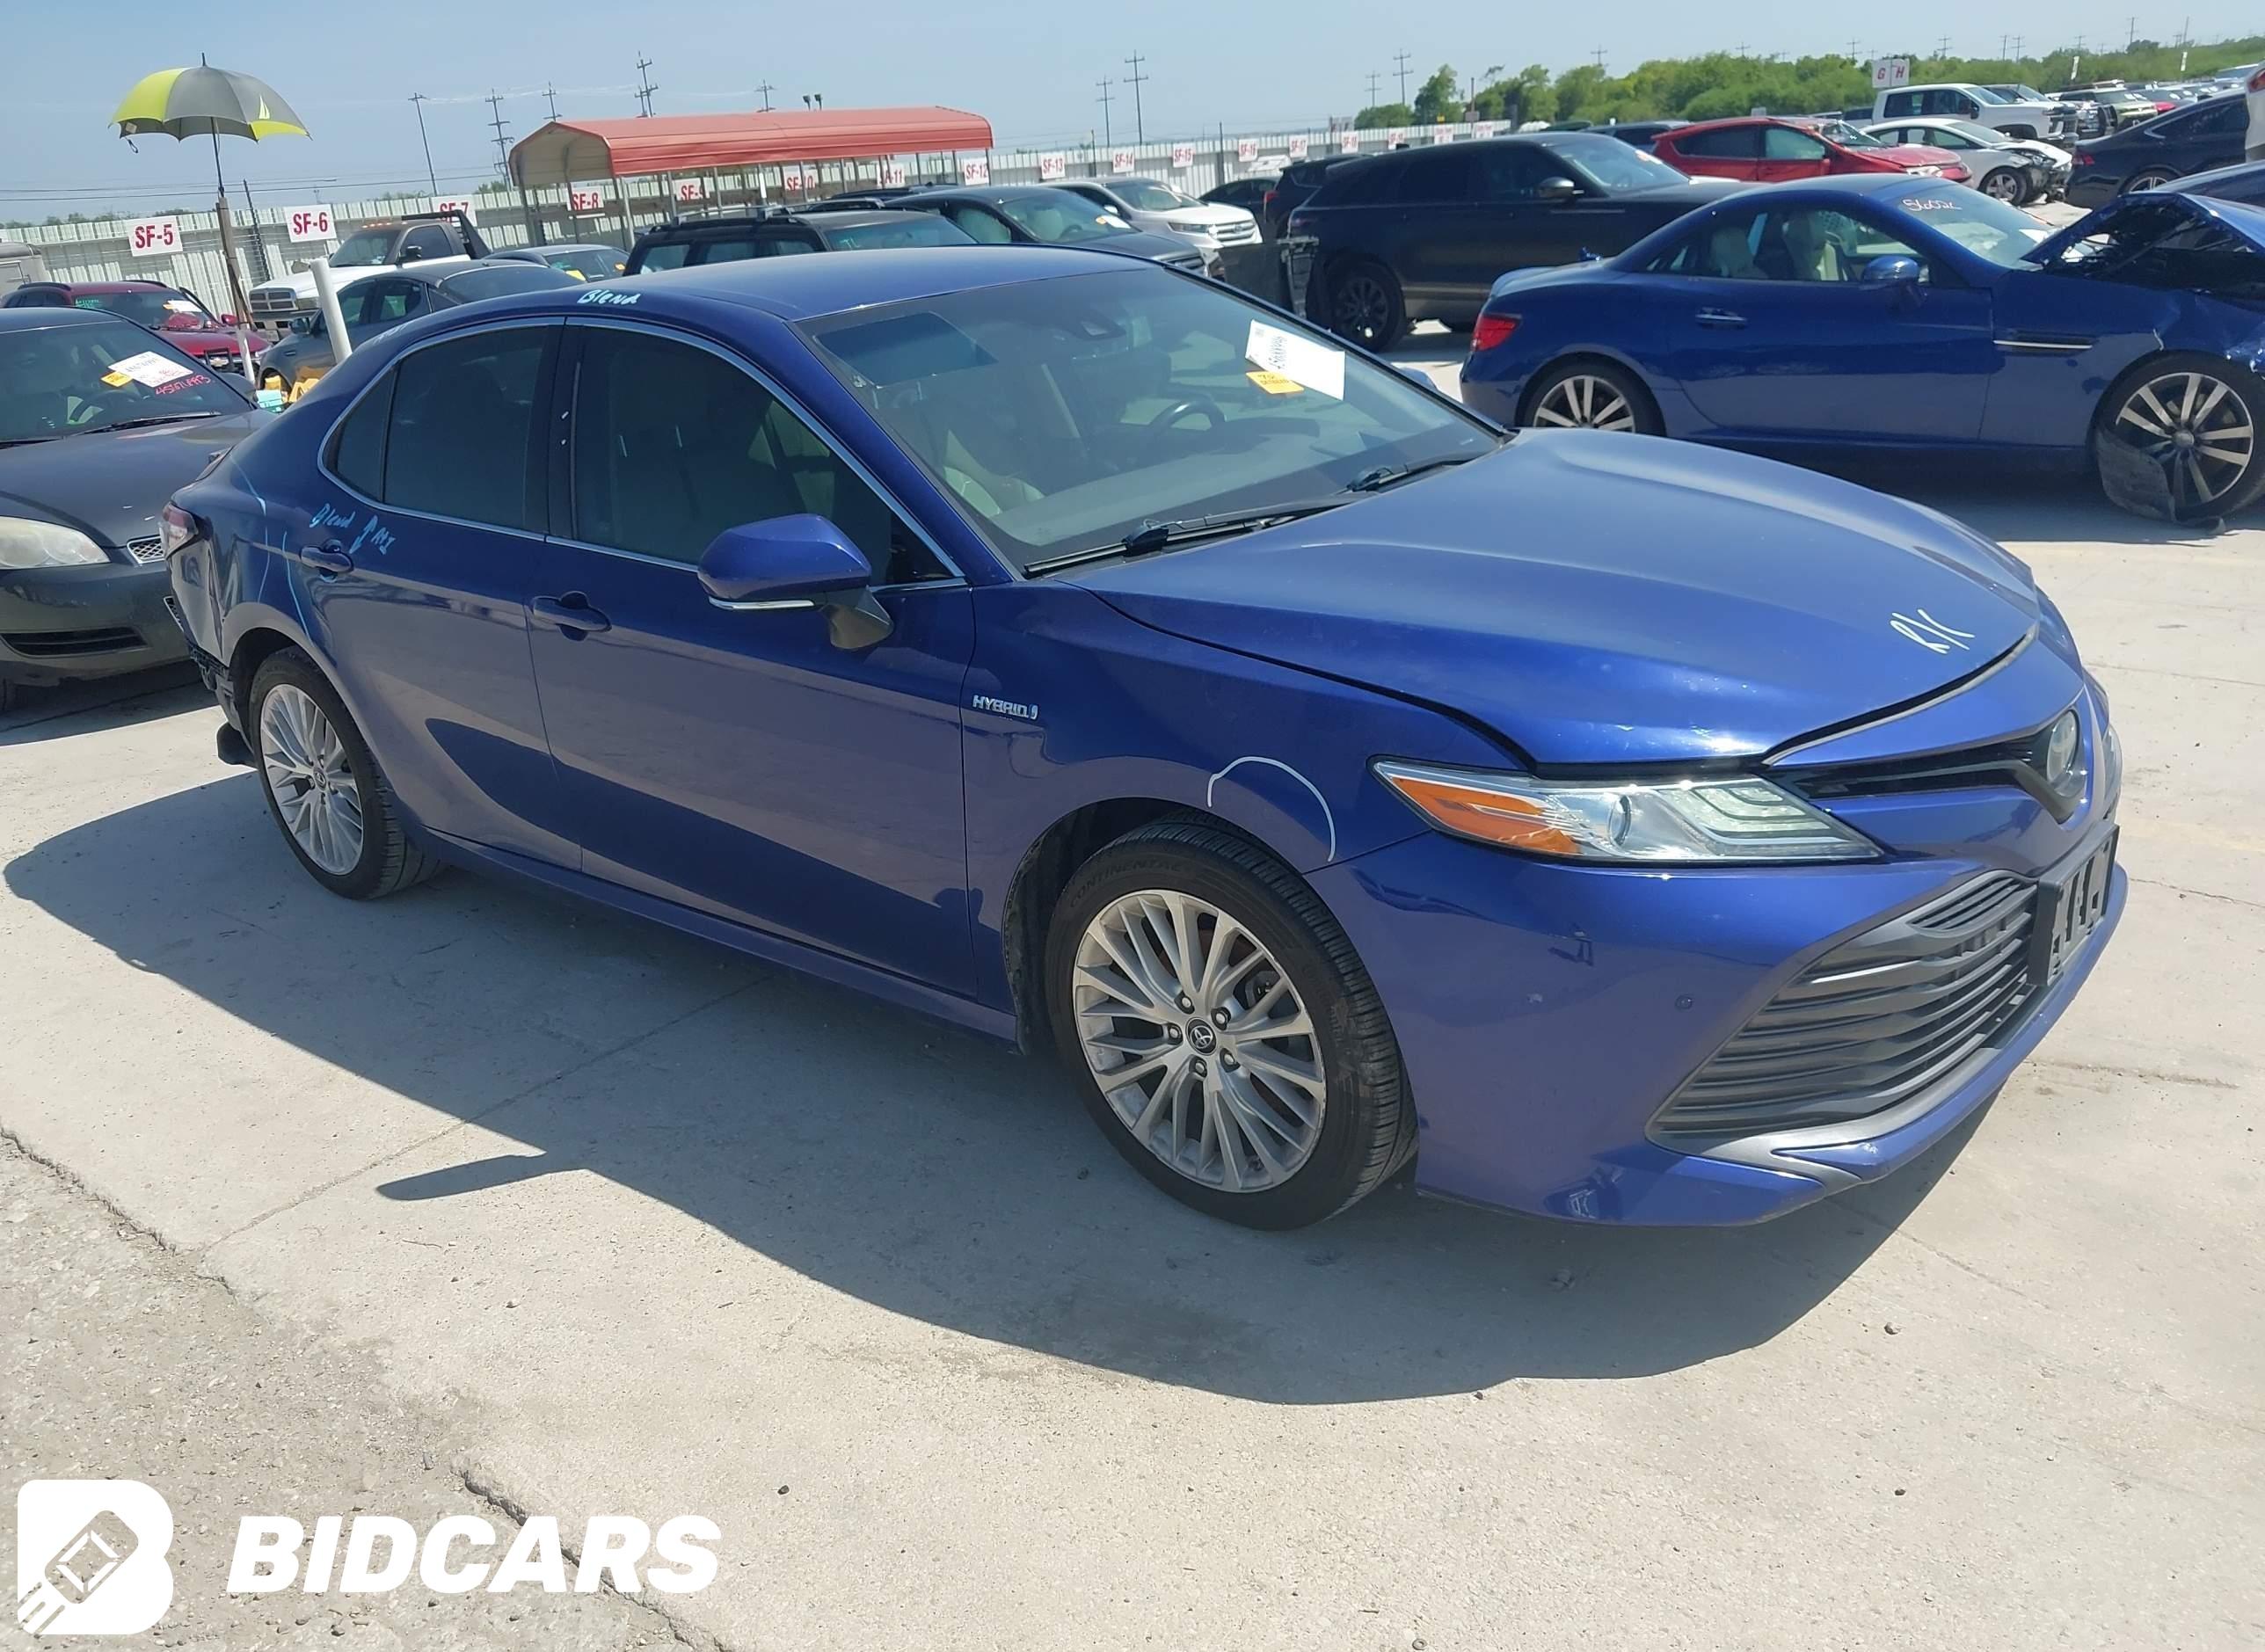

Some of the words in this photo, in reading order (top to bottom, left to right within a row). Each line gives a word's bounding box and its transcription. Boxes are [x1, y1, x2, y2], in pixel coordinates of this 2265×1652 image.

[1895, 65, 1905, 78] H
[1114, 152, 1133, 168] SF-14
[1174, 149, 1193, 163] SF-15
[1043, 158, 1064, 175] SF-13
[572, 192, 599, 210] SF-8
[293, 212, 329, 235] SF-6
[135, 224, 174, 249] SF-5
[972, 695, 1030, 718] HYBRID
